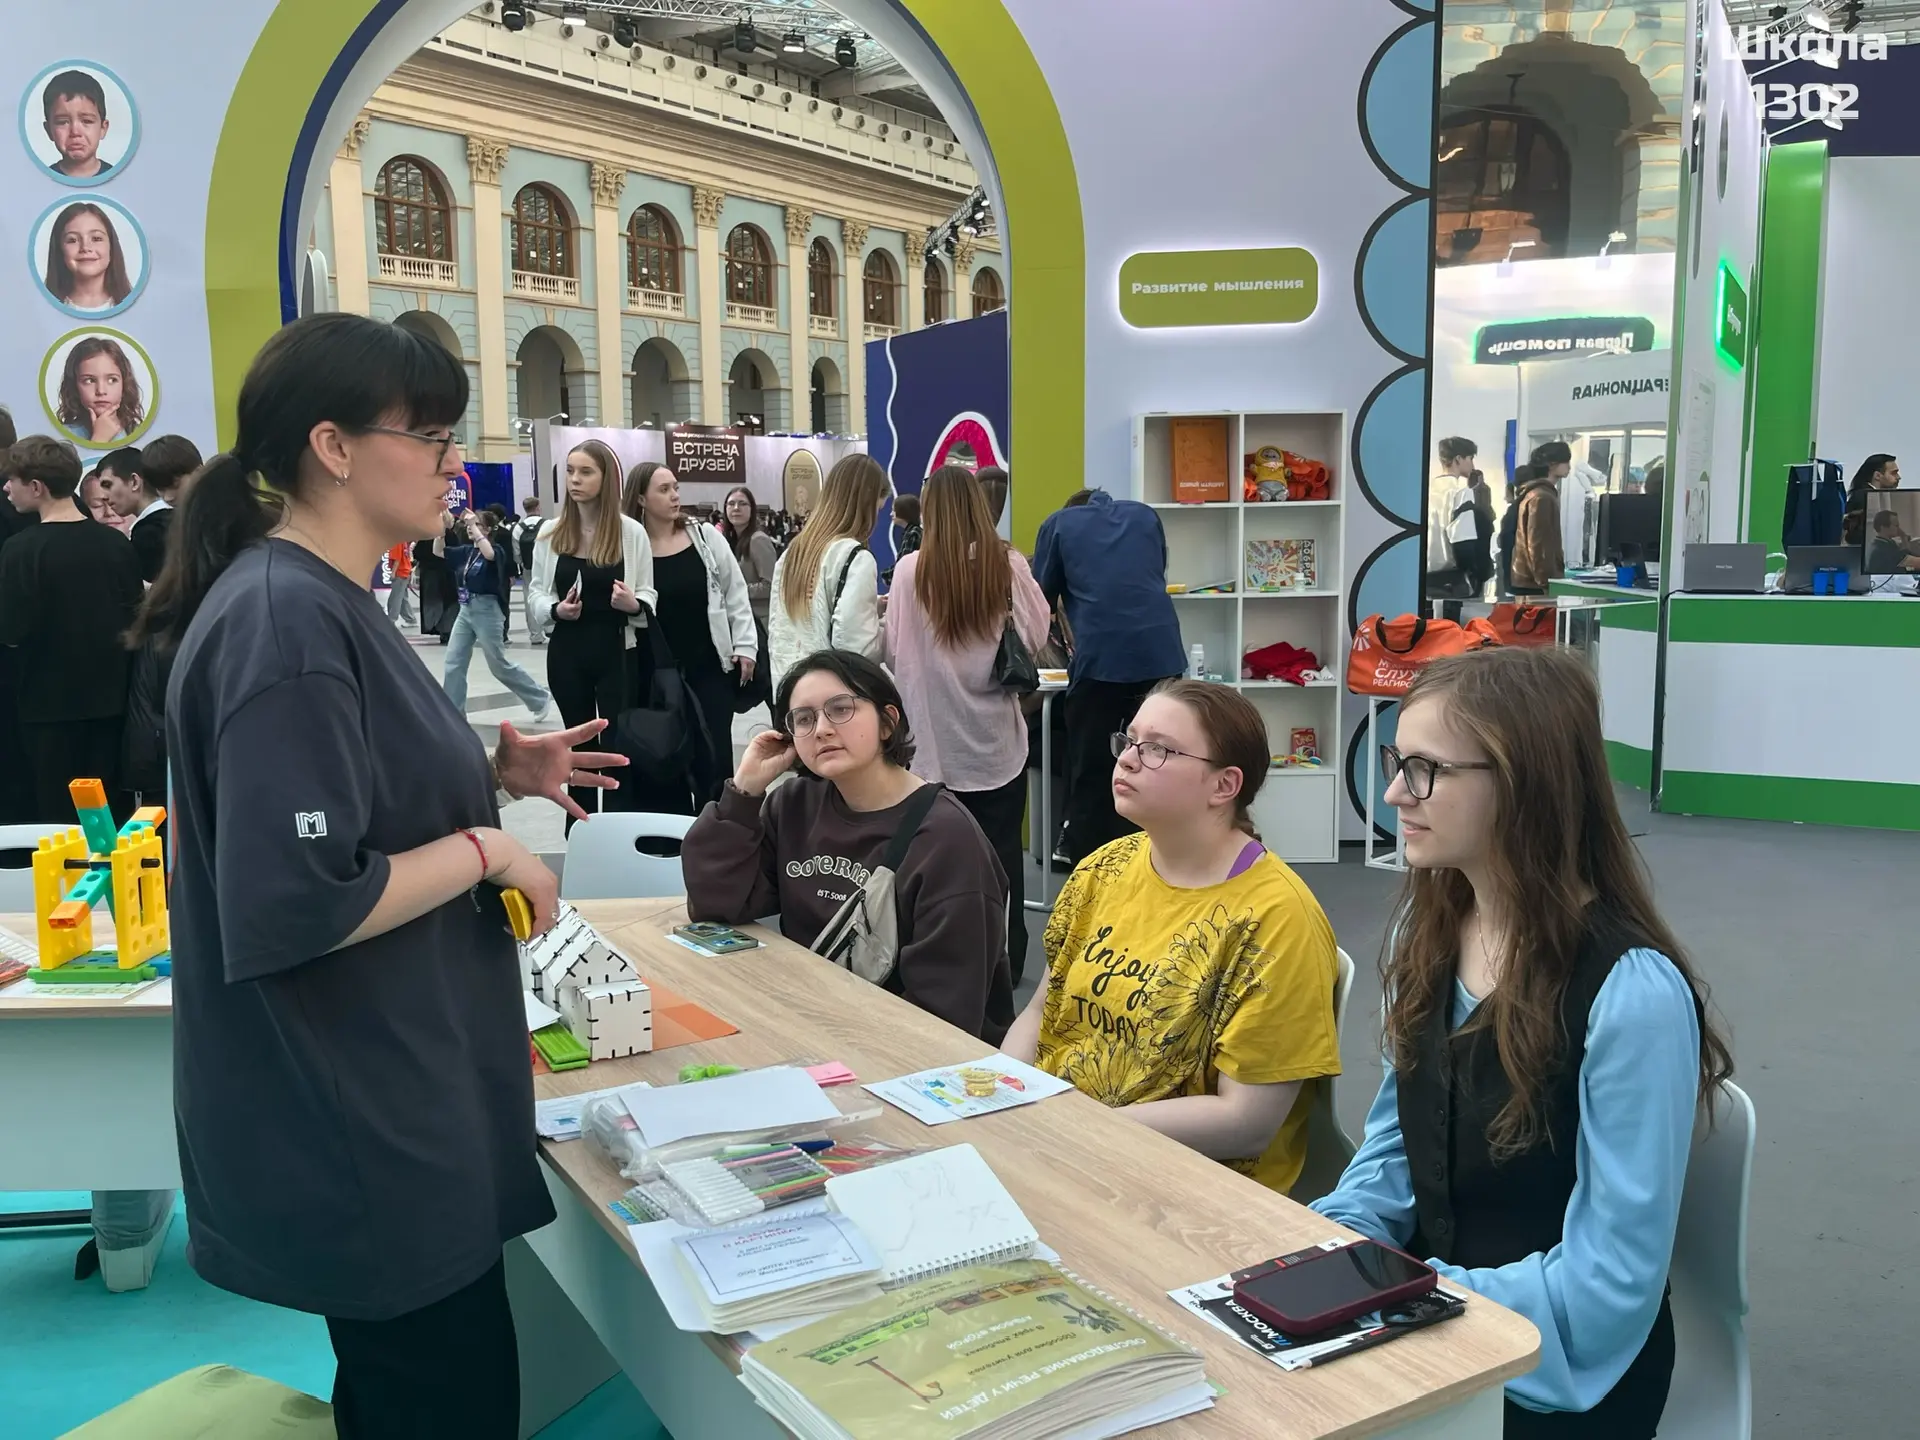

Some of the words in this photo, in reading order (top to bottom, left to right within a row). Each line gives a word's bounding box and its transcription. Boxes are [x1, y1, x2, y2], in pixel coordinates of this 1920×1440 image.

[1132, 282, 1208, 294] Развитие
[1214, 279, 1304, 292] мышления
[673, 441, 740, 457] ВСТРЕЧА
[678, 456, 735, 473] ДРУЗЕЙ
[1374, 668, 1421, 681] СЛУЖ
[1373, 679, 1413, 688] РЕАГИРО
[1084, 926, 1158, 1011] Enjoy
[1071, 995, 1140, 1049] TODAY
[1040, 1337, 1146, 1375] ОБСЛЕДОВАНИЕ
[1000, 1371, 1041, 1393] РЕЧИ
[991, 1386, 1003, 1397] У
[940, 1391, 990, 1421] ДЕТЕЙ
